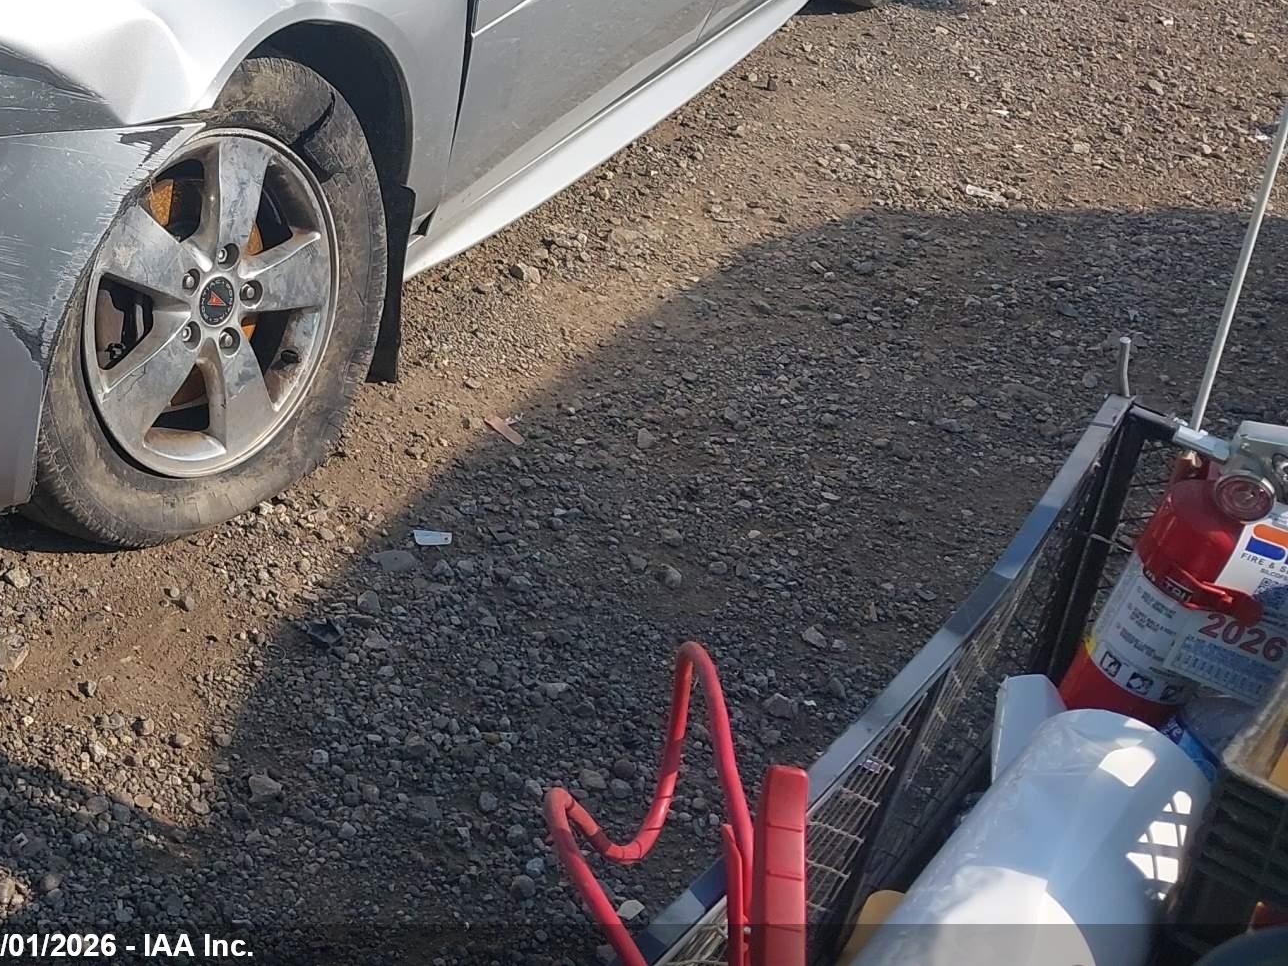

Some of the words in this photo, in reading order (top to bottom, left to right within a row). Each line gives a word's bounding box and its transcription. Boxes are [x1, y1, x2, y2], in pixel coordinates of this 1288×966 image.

[1240, 551, 1266, 566] FIRE
[1268, 561, 1275, 569] &
[1279, 565, 1288, 575] S
[1198, 613, 1288, 662] 2026
